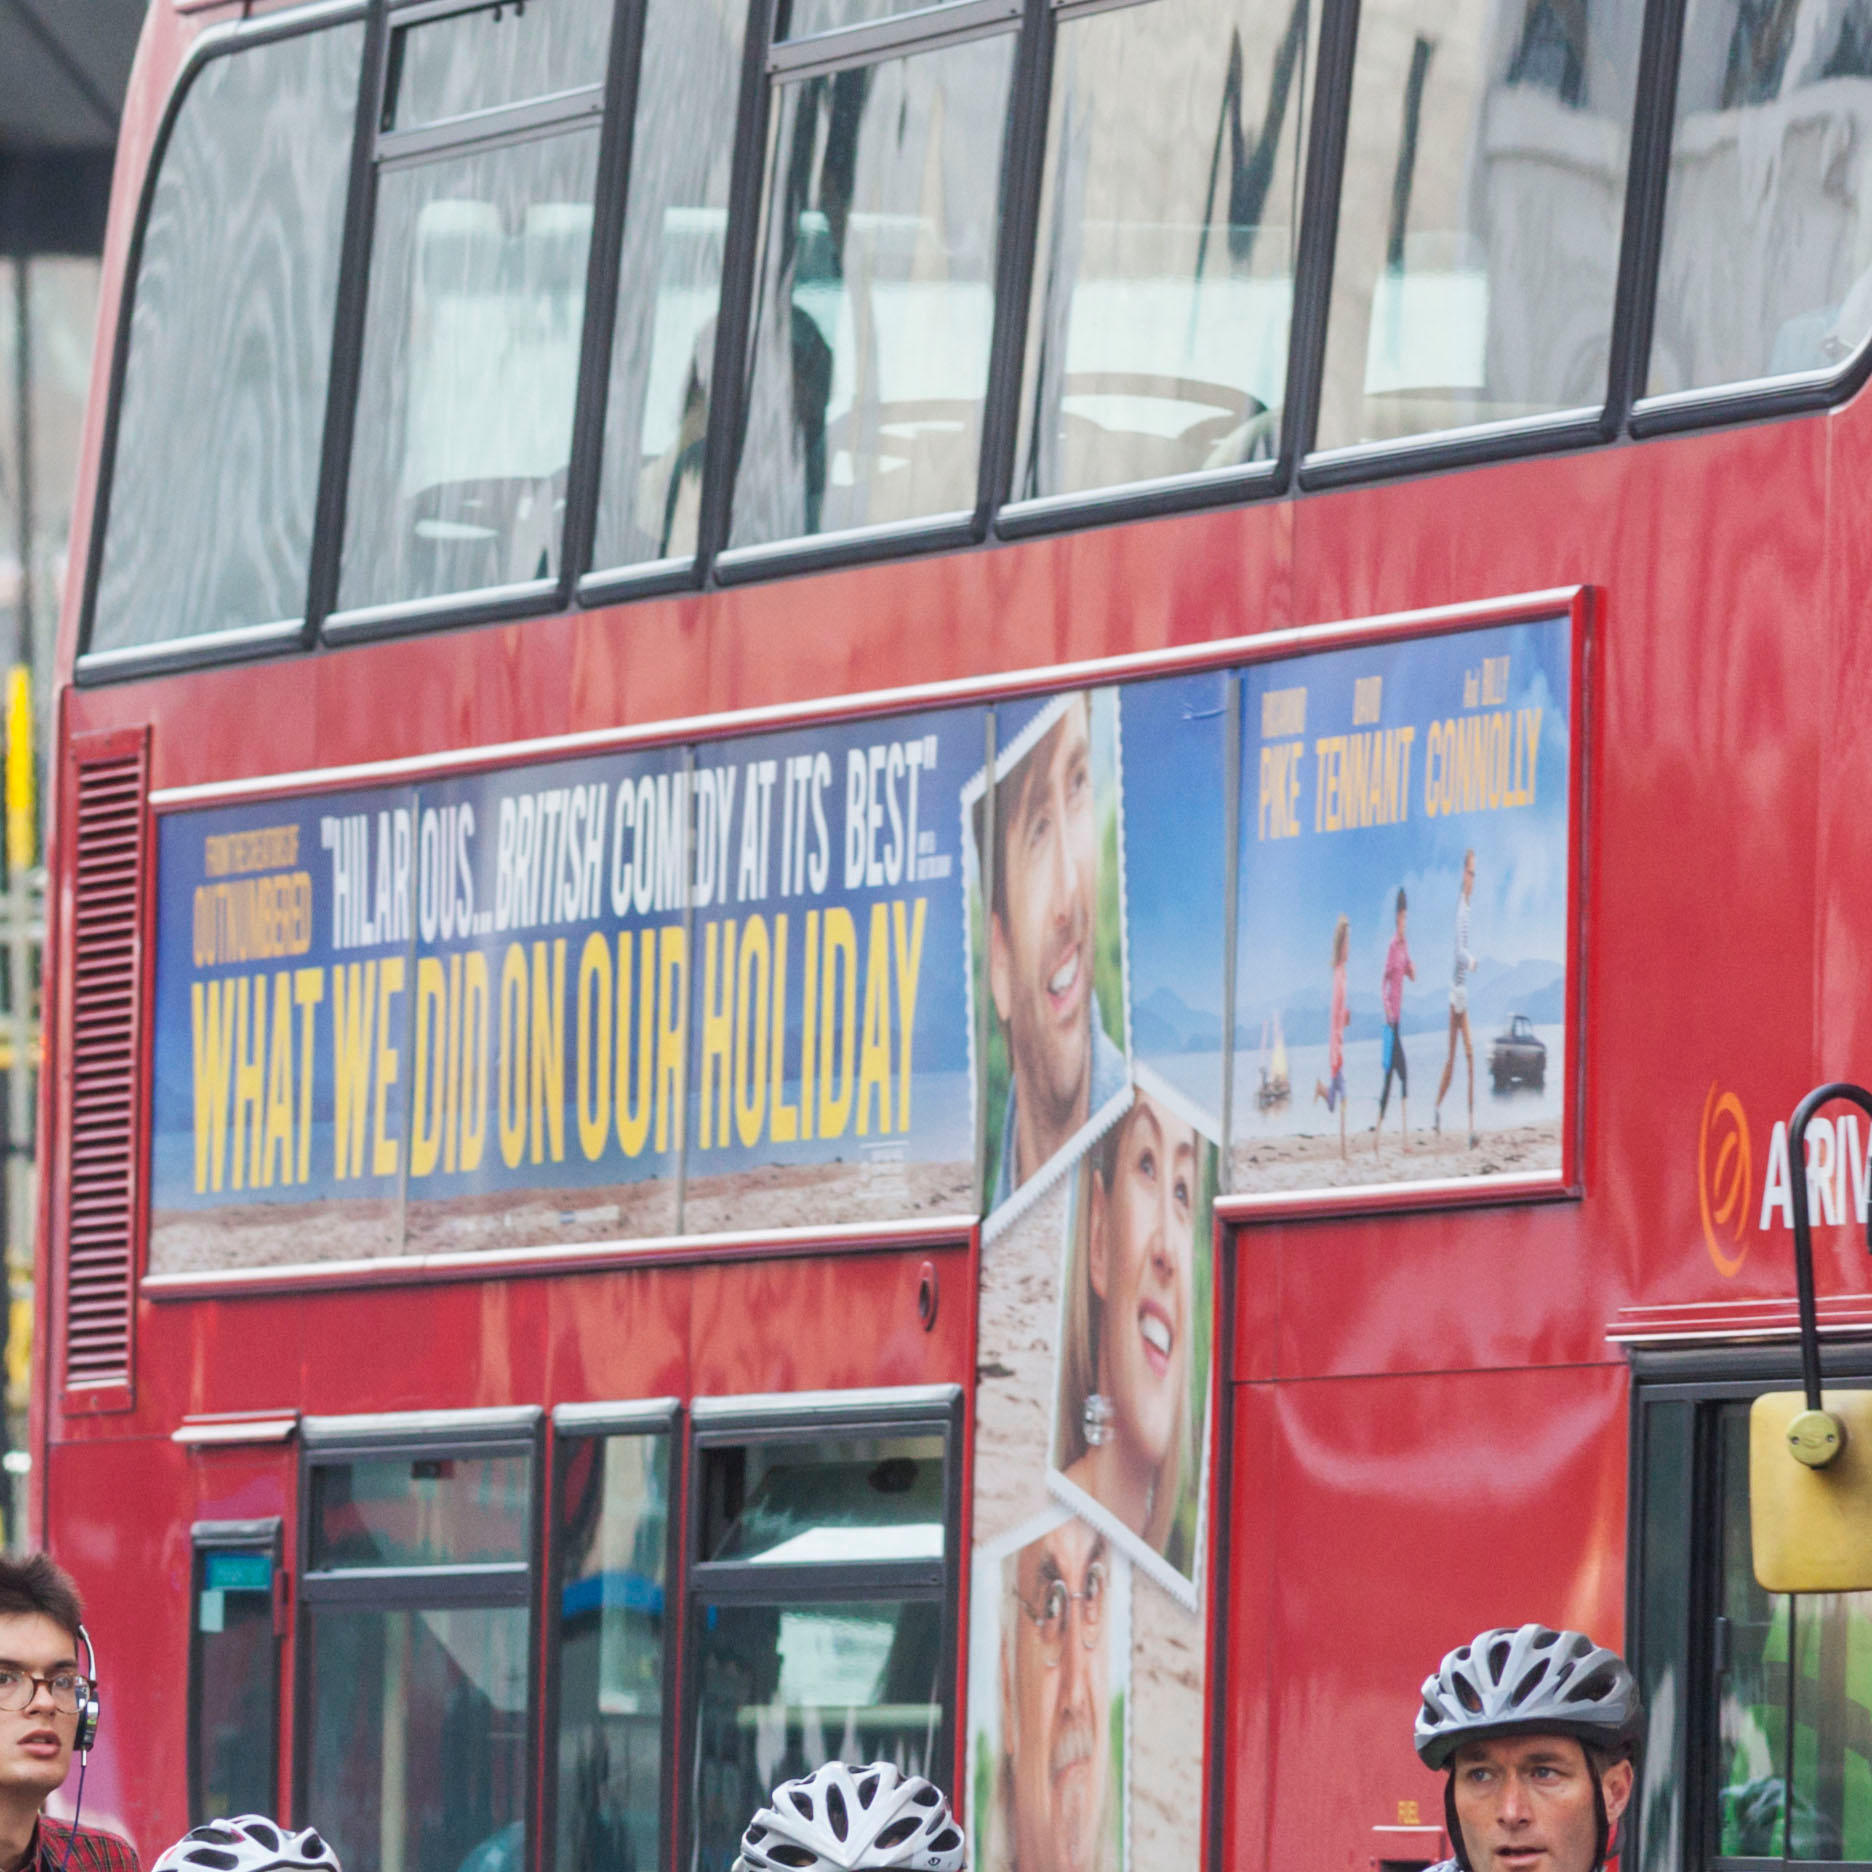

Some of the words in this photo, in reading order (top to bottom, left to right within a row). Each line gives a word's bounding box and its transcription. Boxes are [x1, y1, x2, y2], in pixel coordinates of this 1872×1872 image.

[737, 760, 777, 901] AT
[780, 752, 831, 897] ITS
[1259, 742, 1304, 840] PIKE
[1315, 726, 1415, 832] TENNANT
[1426, 708, 1543, 817] CONNOLLY
[192, 967, 324, 1194] WHAT
[332, 956, 405, 1180] WE
[411, 951, 489, 1177] DID
[499, 938, 566, 1169] ON
[577, 926, 686, 1161] OUR
[700, 898, 927, 1149] HOLIDAY
[1759, 1115, 1872, 1230] ARIV
